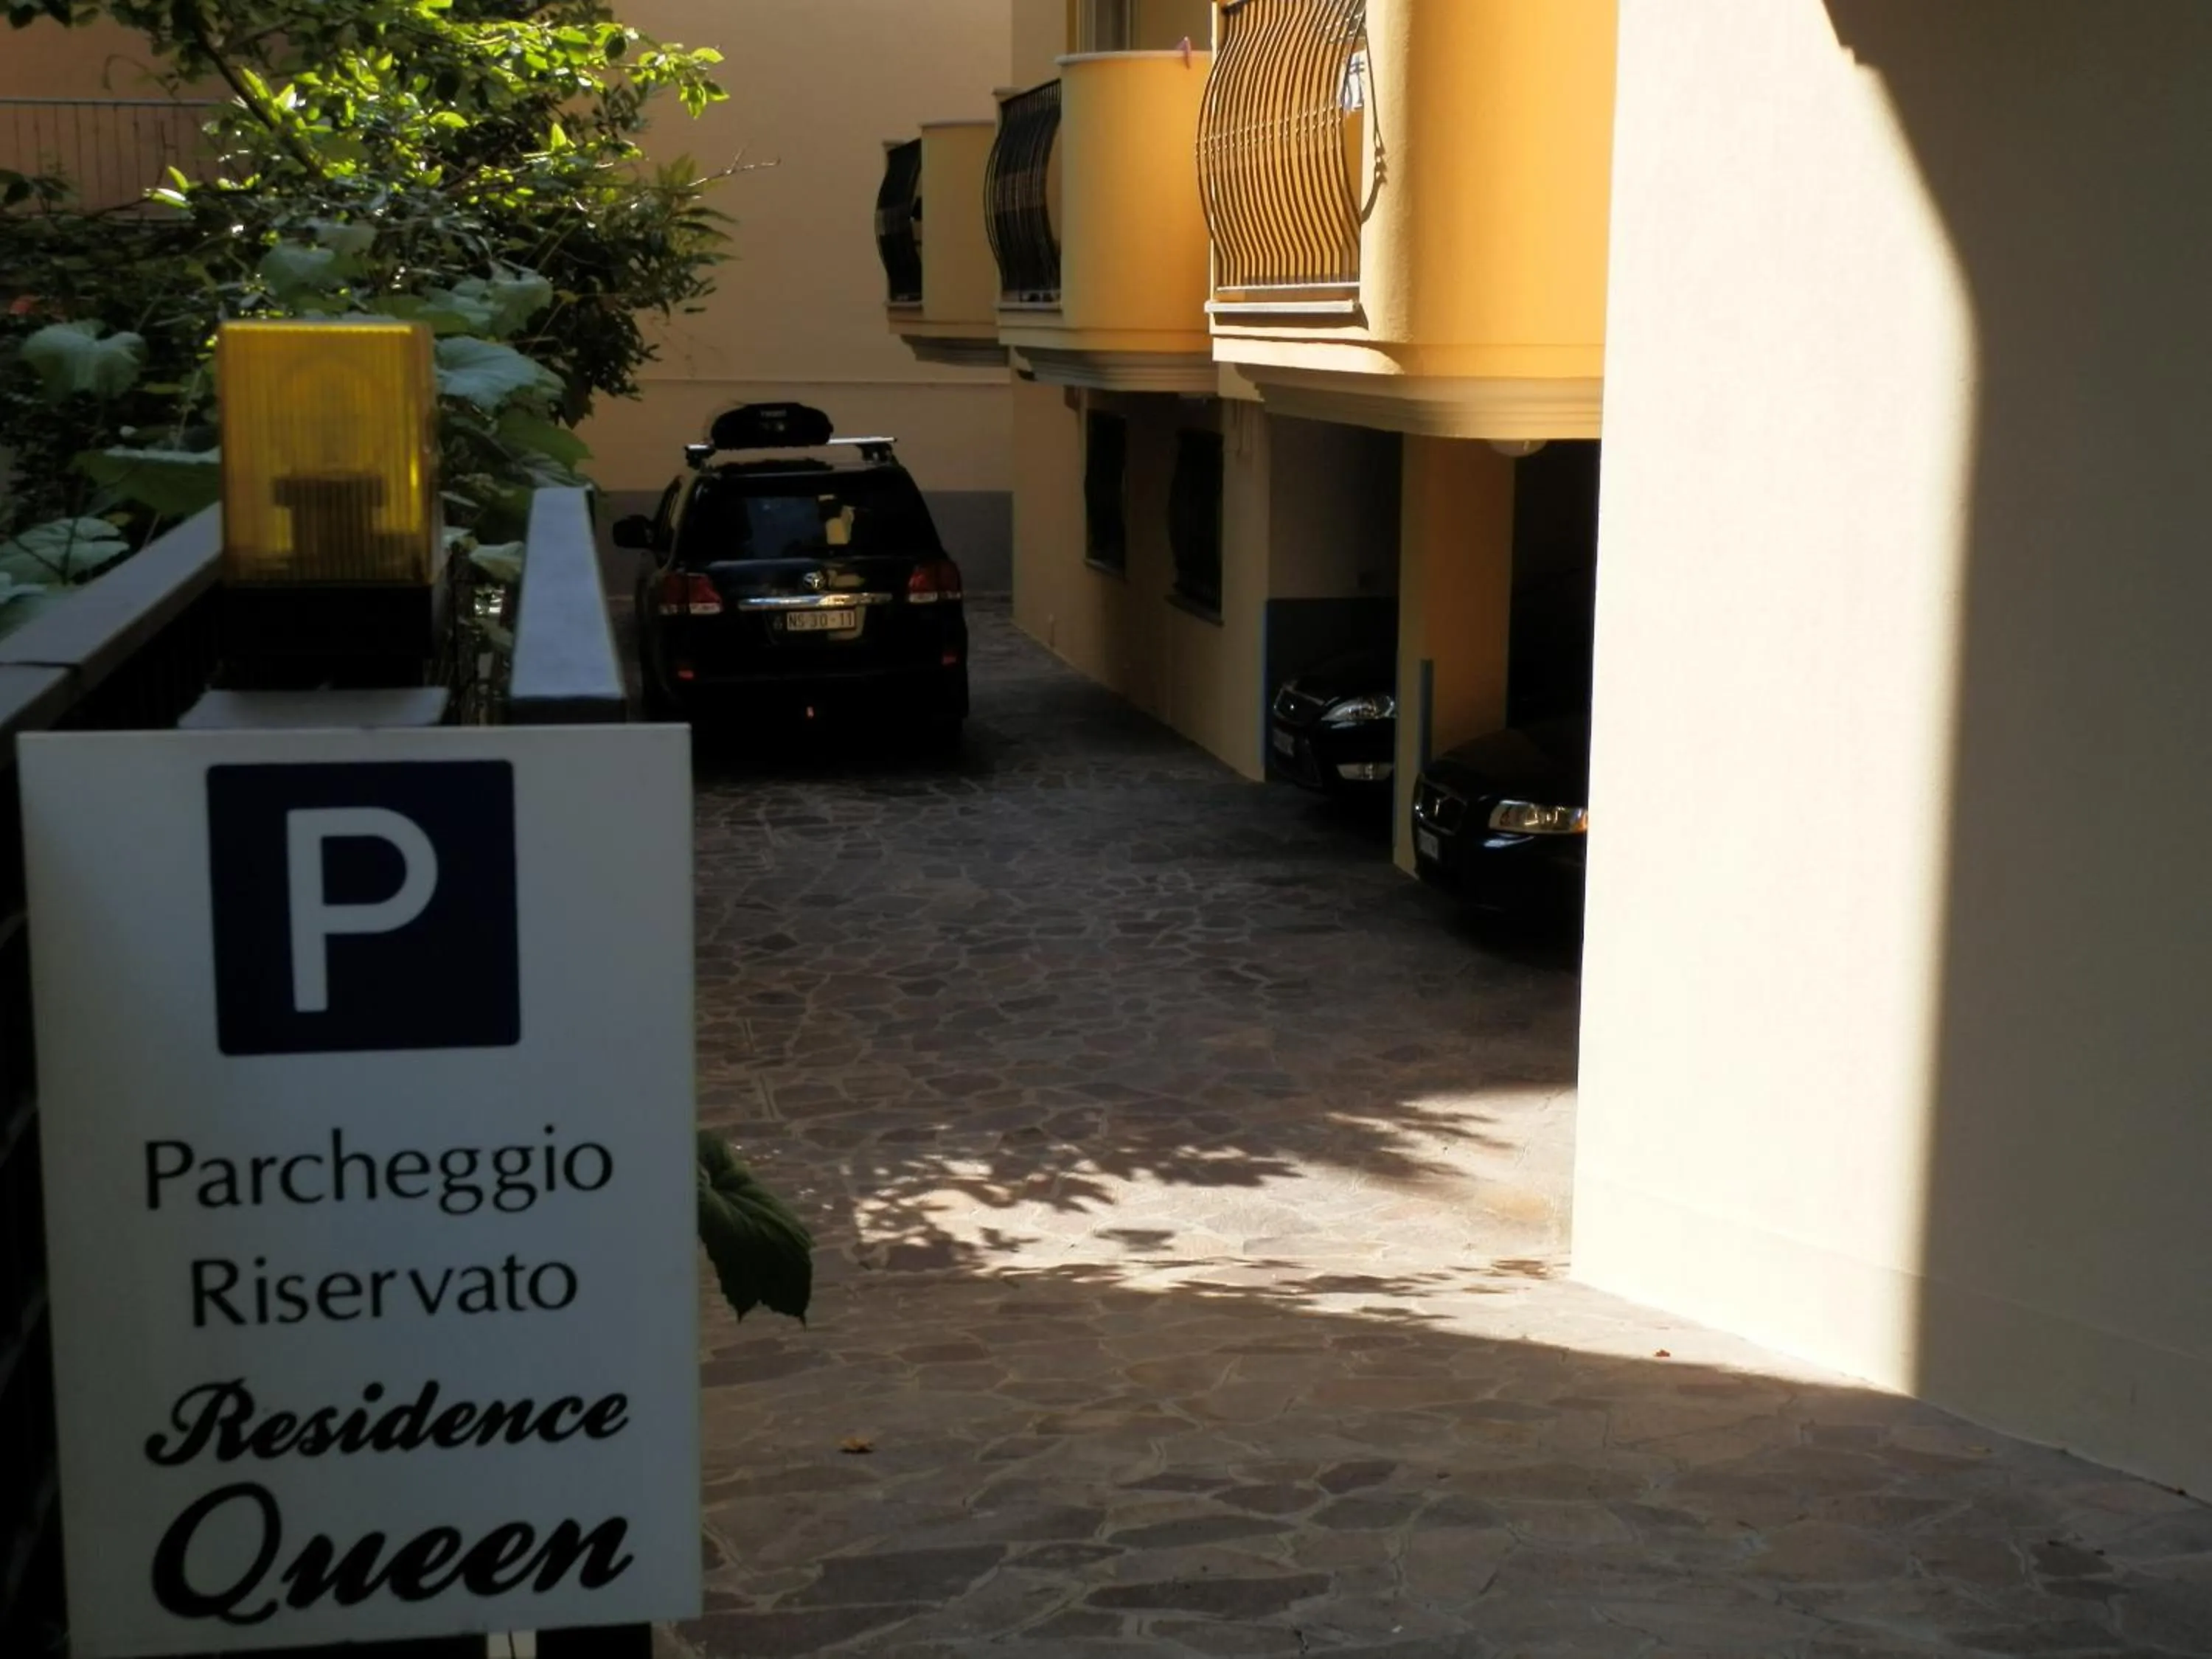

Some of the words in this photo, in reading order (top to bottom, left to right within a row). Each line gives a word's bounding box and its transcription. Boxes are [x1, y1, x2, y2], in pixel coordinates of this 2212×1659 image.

[286, 807, 438, 1012] P
[145, 1124, 614, 1216] Parcheggio
[189, 1254, 578, 1329] Riservato
[143, 1377, 630, 1469] Residence
[150, 1481, 635, 1627] Queen
